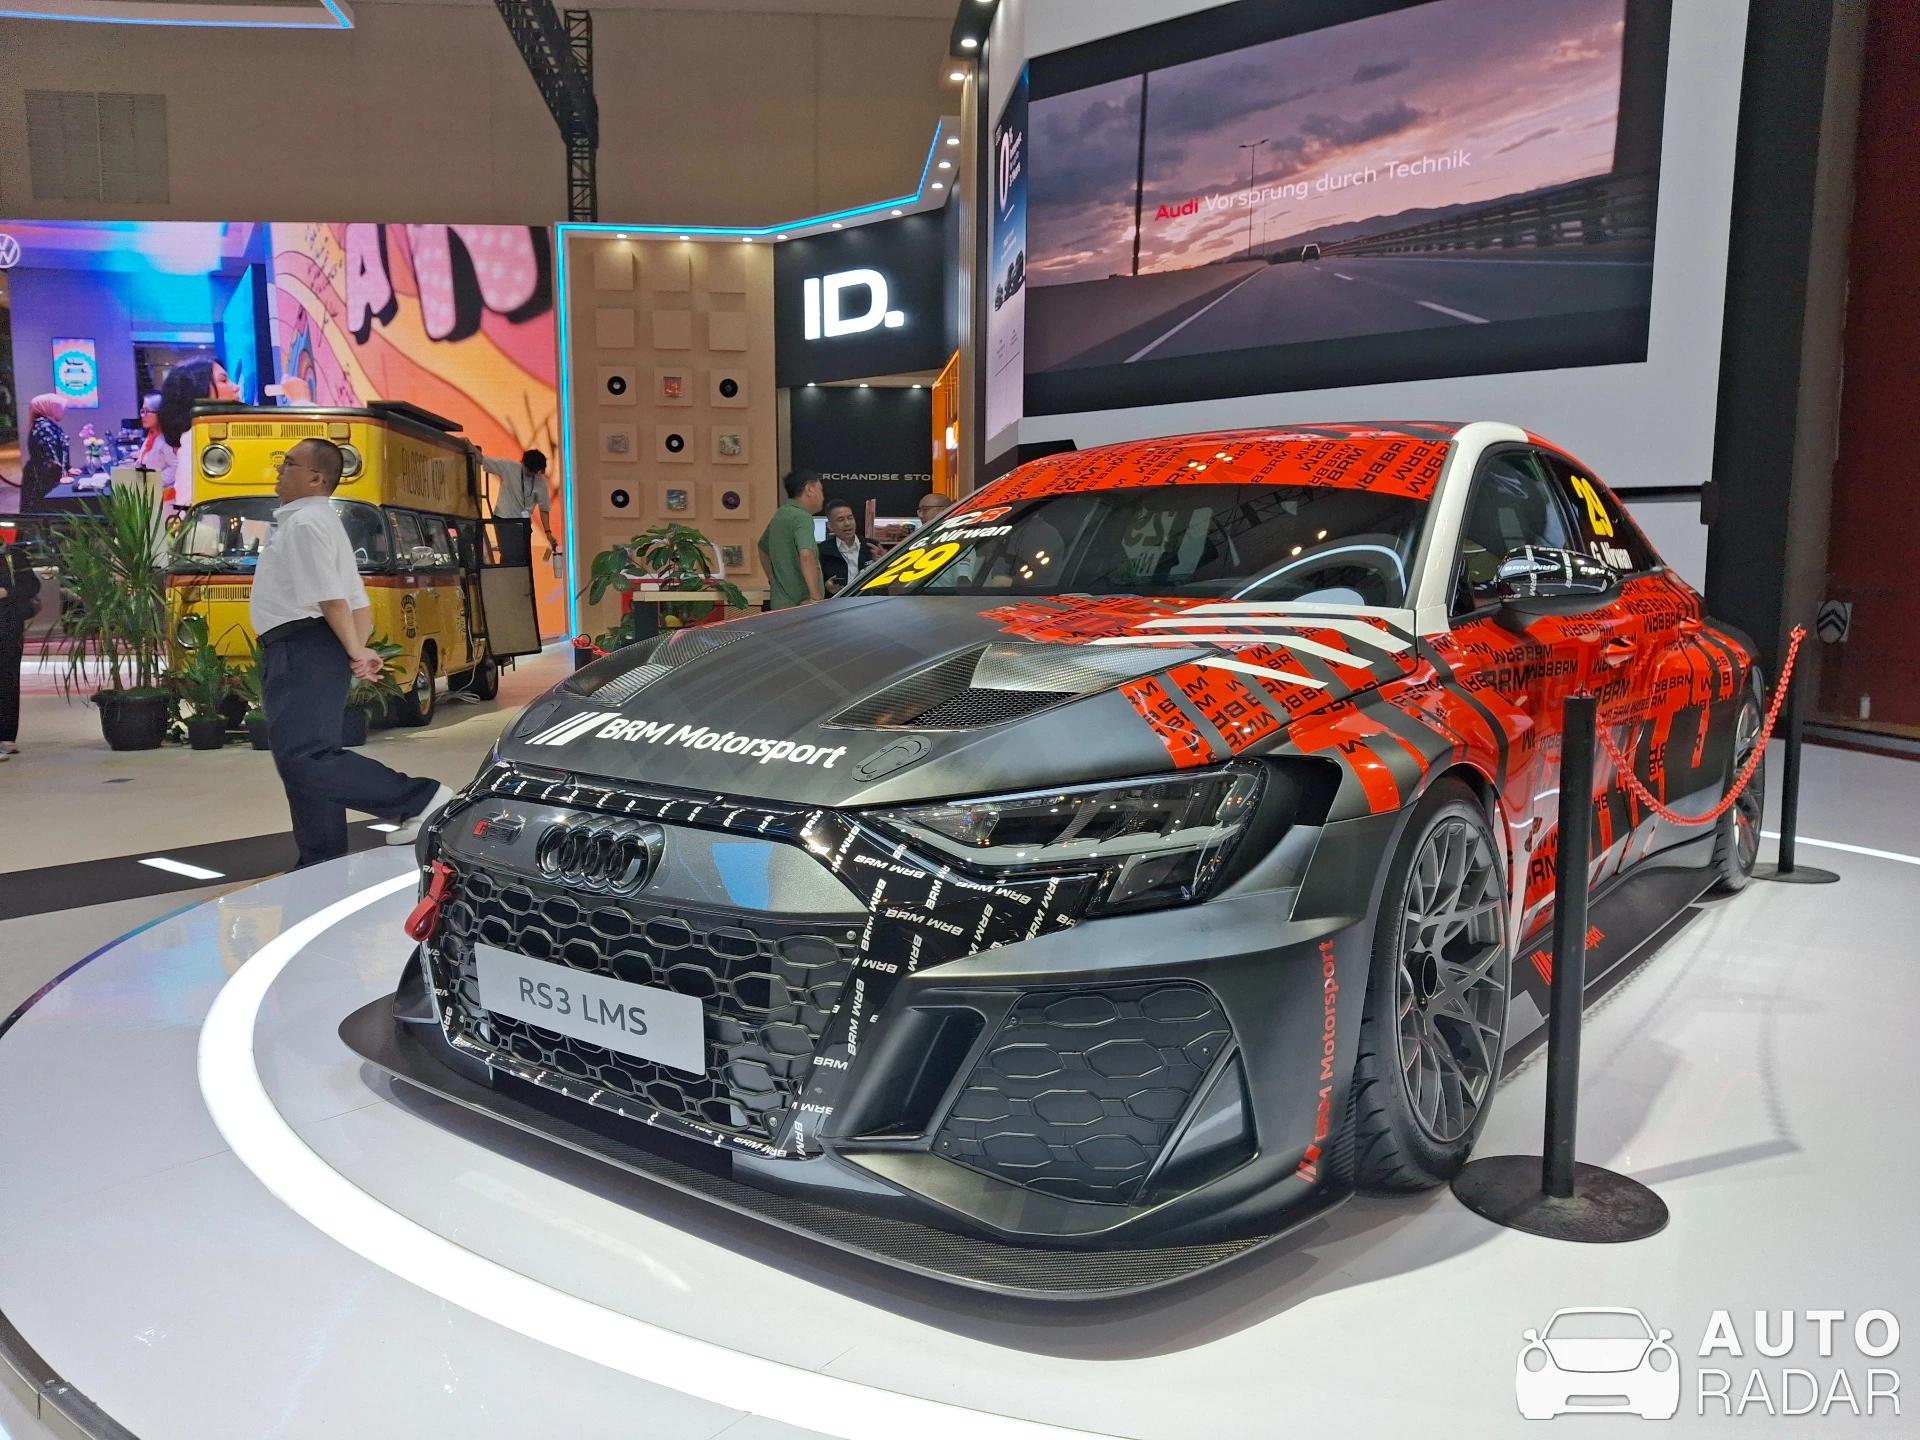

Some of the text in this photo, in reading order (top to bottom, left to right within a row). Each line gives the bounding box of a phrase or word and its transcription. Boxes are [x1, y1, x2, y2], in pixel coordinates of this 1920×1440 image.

[1155, 150, 1471, 220] Audi Vorsprung durch Technik
[803, 268, 904, 340] ID.
[904, 473, 933, 481] STO
[1570, 475, 1614, 538] 29
[908, 525, 1013, 551] G. Nirwan
[860, 542, 960, 590] 29
[596, 719, 848, 769] BRM Motorsport
[854, 854, 889, 870] BRM
[888, 864, 927, 879] BRM
[860, 878, 887, 951] BRM BRM
[924, 879, 943, 911] BRM
[884, 908, 964, 936] BRM BRM
[973, 903, 994, 942] BRM
[861, 959, 899, 974] BRM
[907, 933, 923, 972] BRM
[518, 976, 649, 1036] RS3 LMS
[847, 978, 865, 1057] BRM BRM
[1319, 938, 1340, 1081] Motorsport
[812, 1055, 849, 1070] BRM
[794, 1120, 807, 1157] BRM
